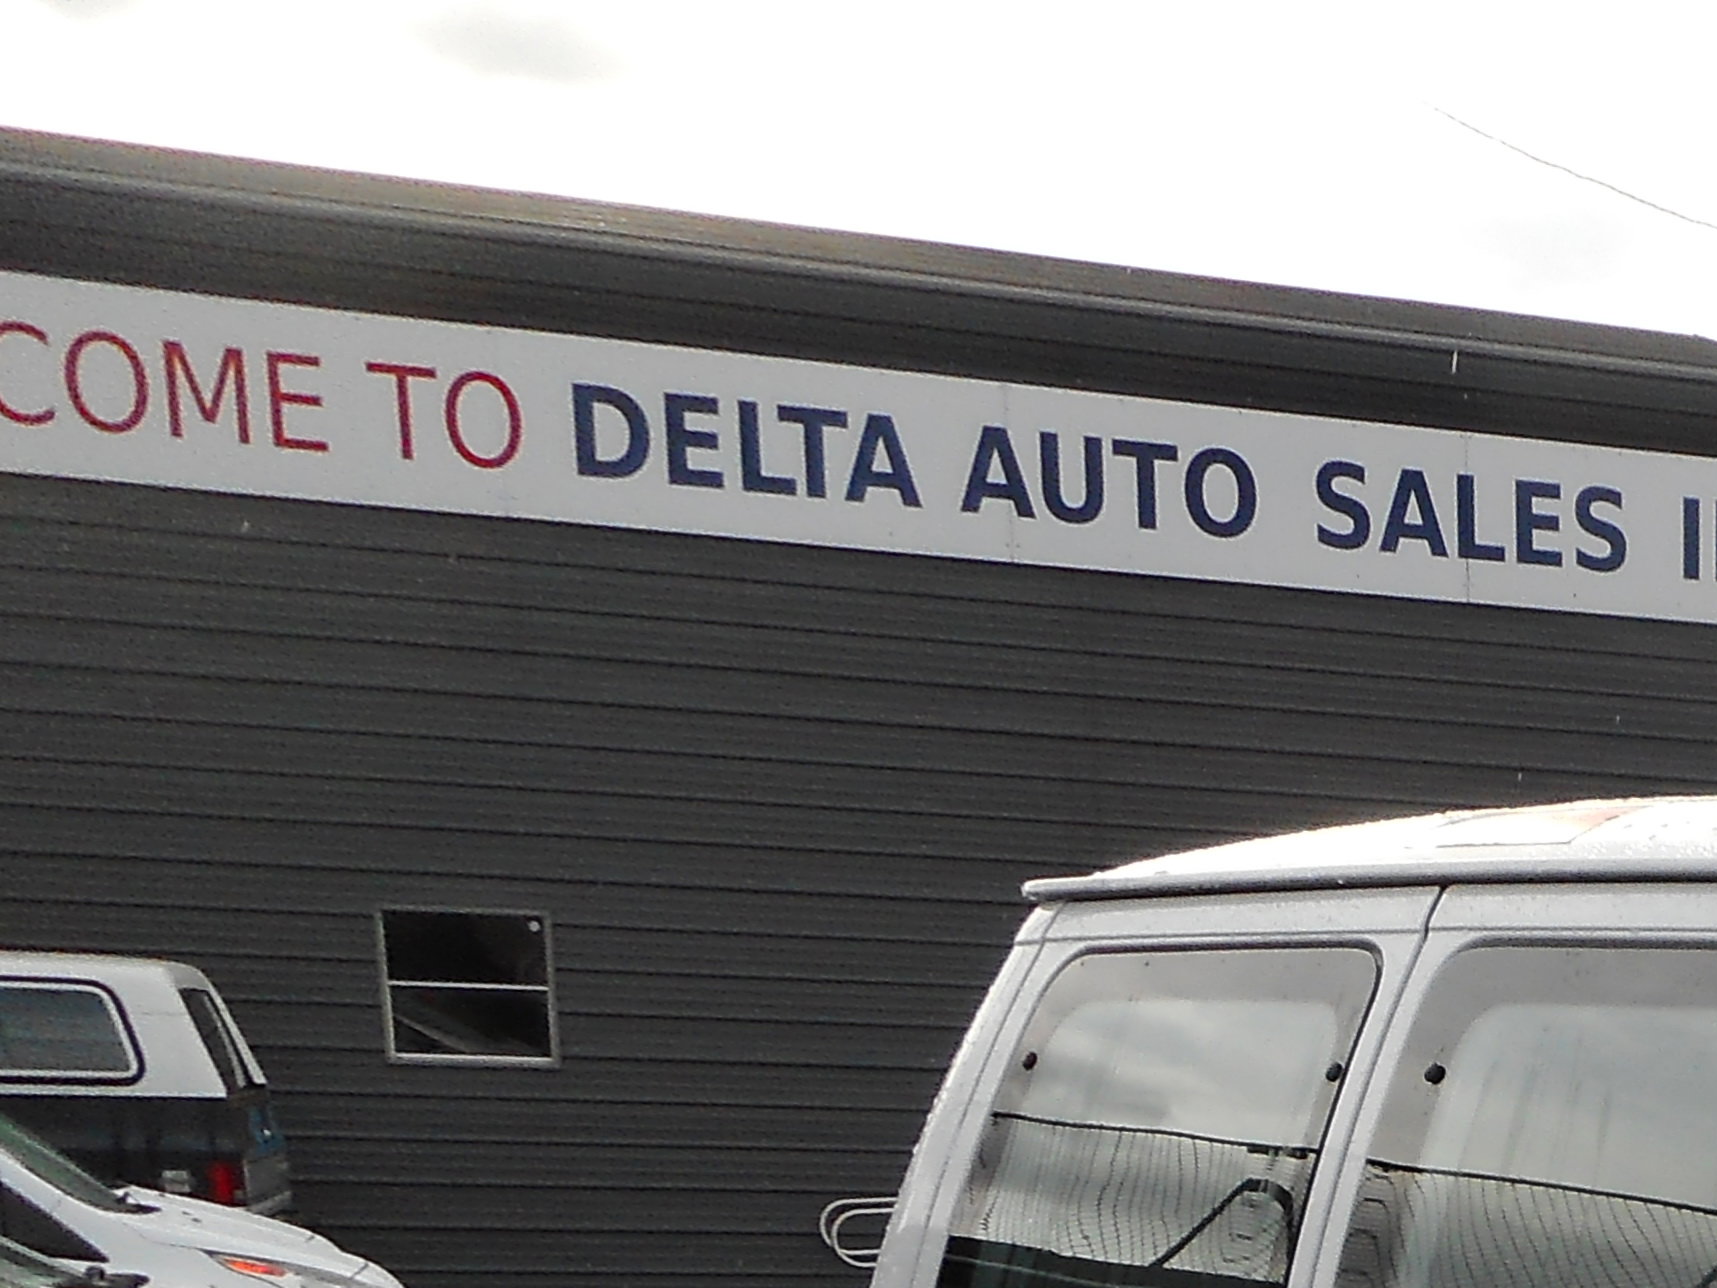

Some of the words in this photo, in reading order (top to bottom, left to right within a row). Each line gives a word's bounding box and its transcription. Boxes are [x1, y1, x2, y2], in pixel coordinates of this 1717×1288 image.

[366, 361, 522, 469] TO
[571, 382, 922, 509] DELTA
[962, 425, 1257, 538] AUTO
[1314, 460, 1628, 572] SALES
